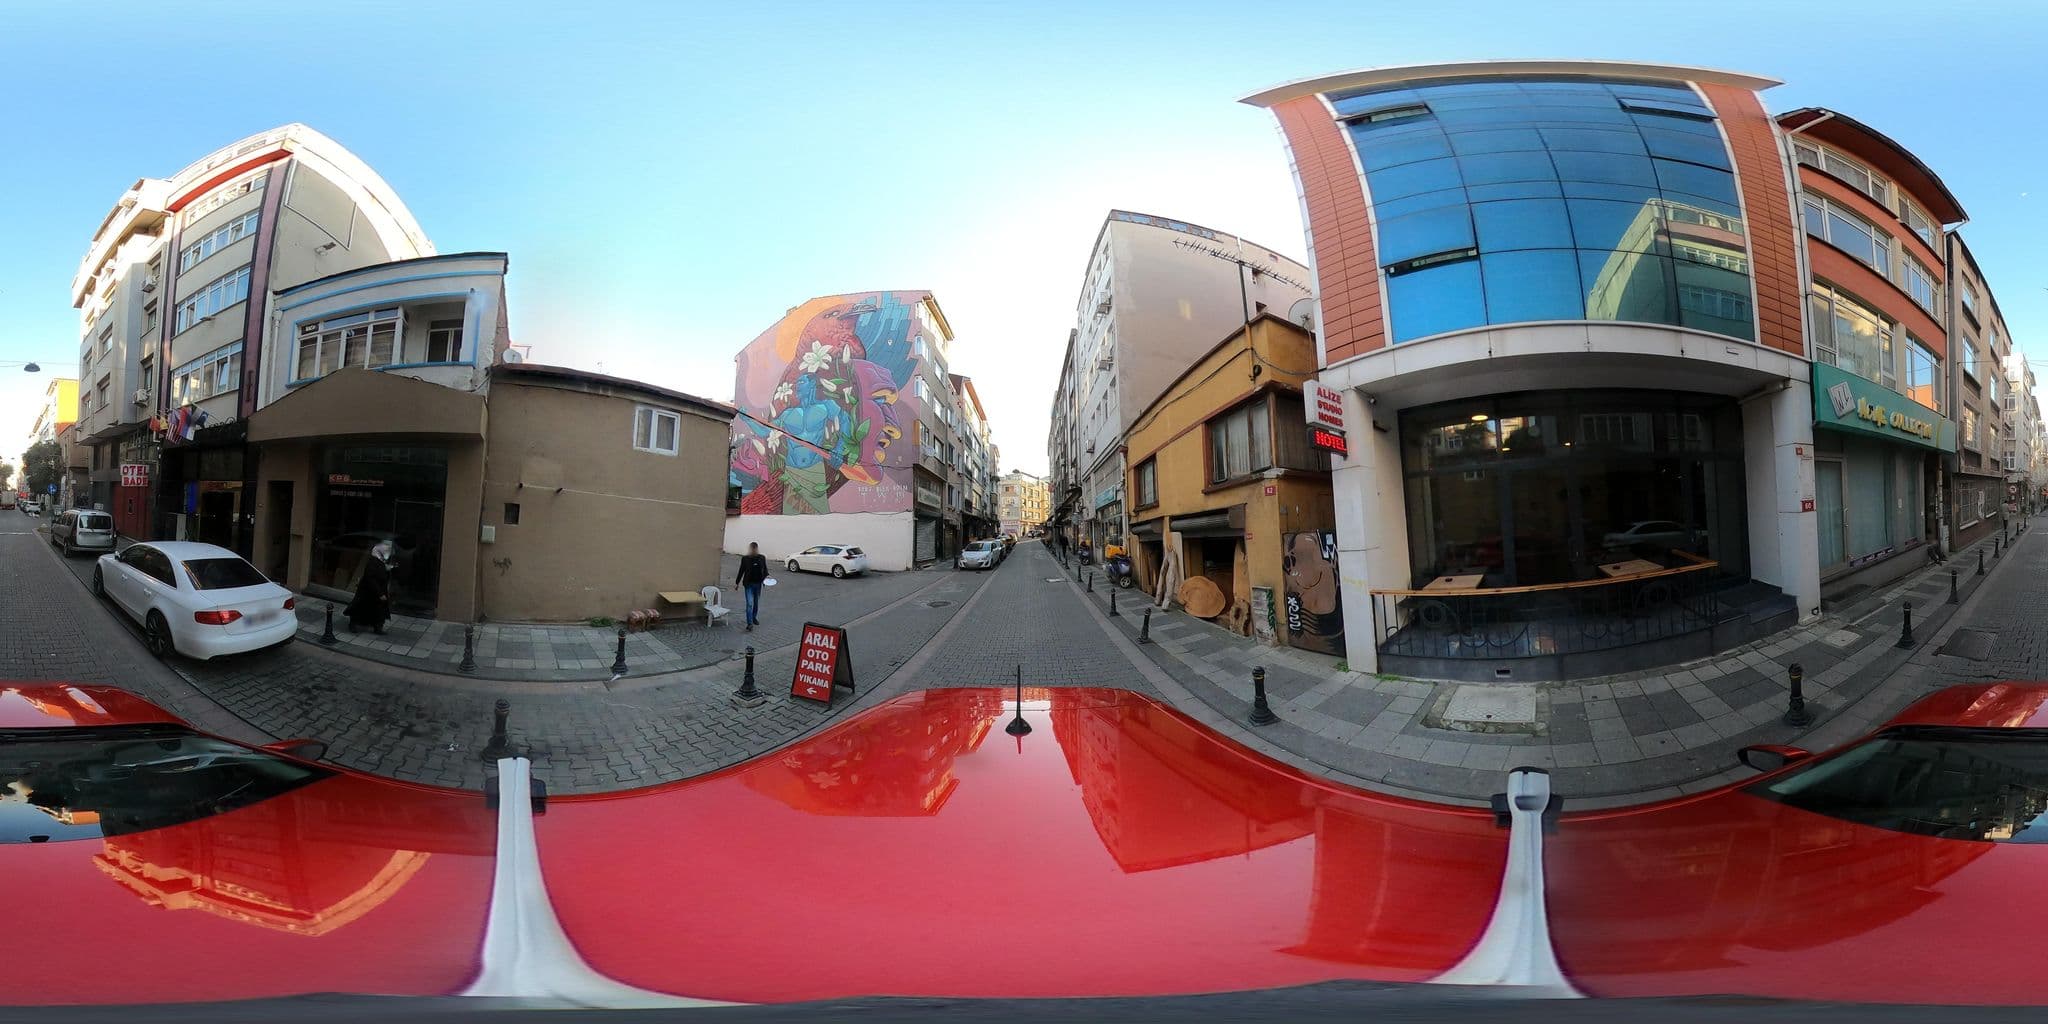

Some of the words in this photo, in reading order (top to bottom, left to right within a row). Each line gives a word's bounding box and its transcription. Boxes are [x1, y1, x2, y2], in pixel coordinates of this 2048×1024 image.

[1315, 430, 1347, 451] HOTEL
[122, 465, 149, 476] OTEL
[123, 477, 148, 486] BADE
[805, 632, 836, 650] ARAL
[807, 649, 829, 661] OTO
[801, 660, 832, 675] PARK
[799, 673, 829, 689] YIKAMA
